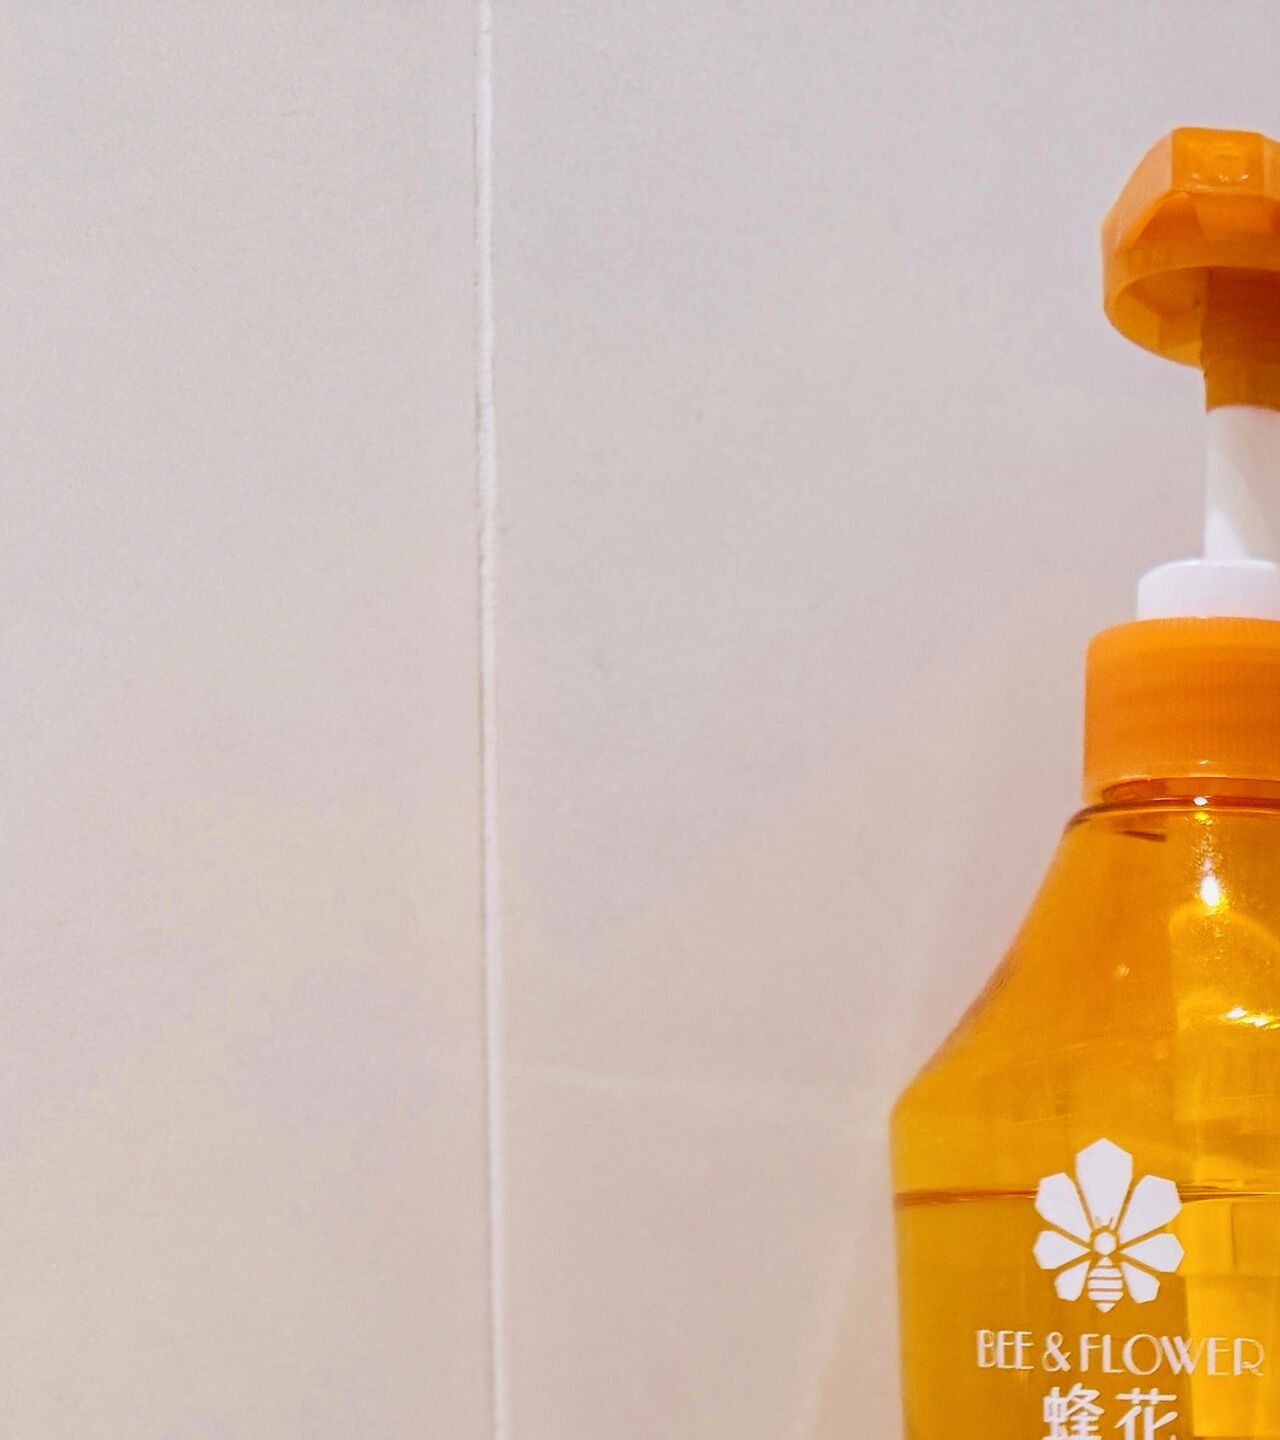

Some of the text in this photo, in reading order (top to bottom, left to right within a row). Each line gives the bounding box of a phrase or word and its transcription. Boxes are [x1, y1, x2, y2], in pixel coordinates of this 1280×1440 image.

[976, 1329, 1266, 1377] BEE & FLOWER
